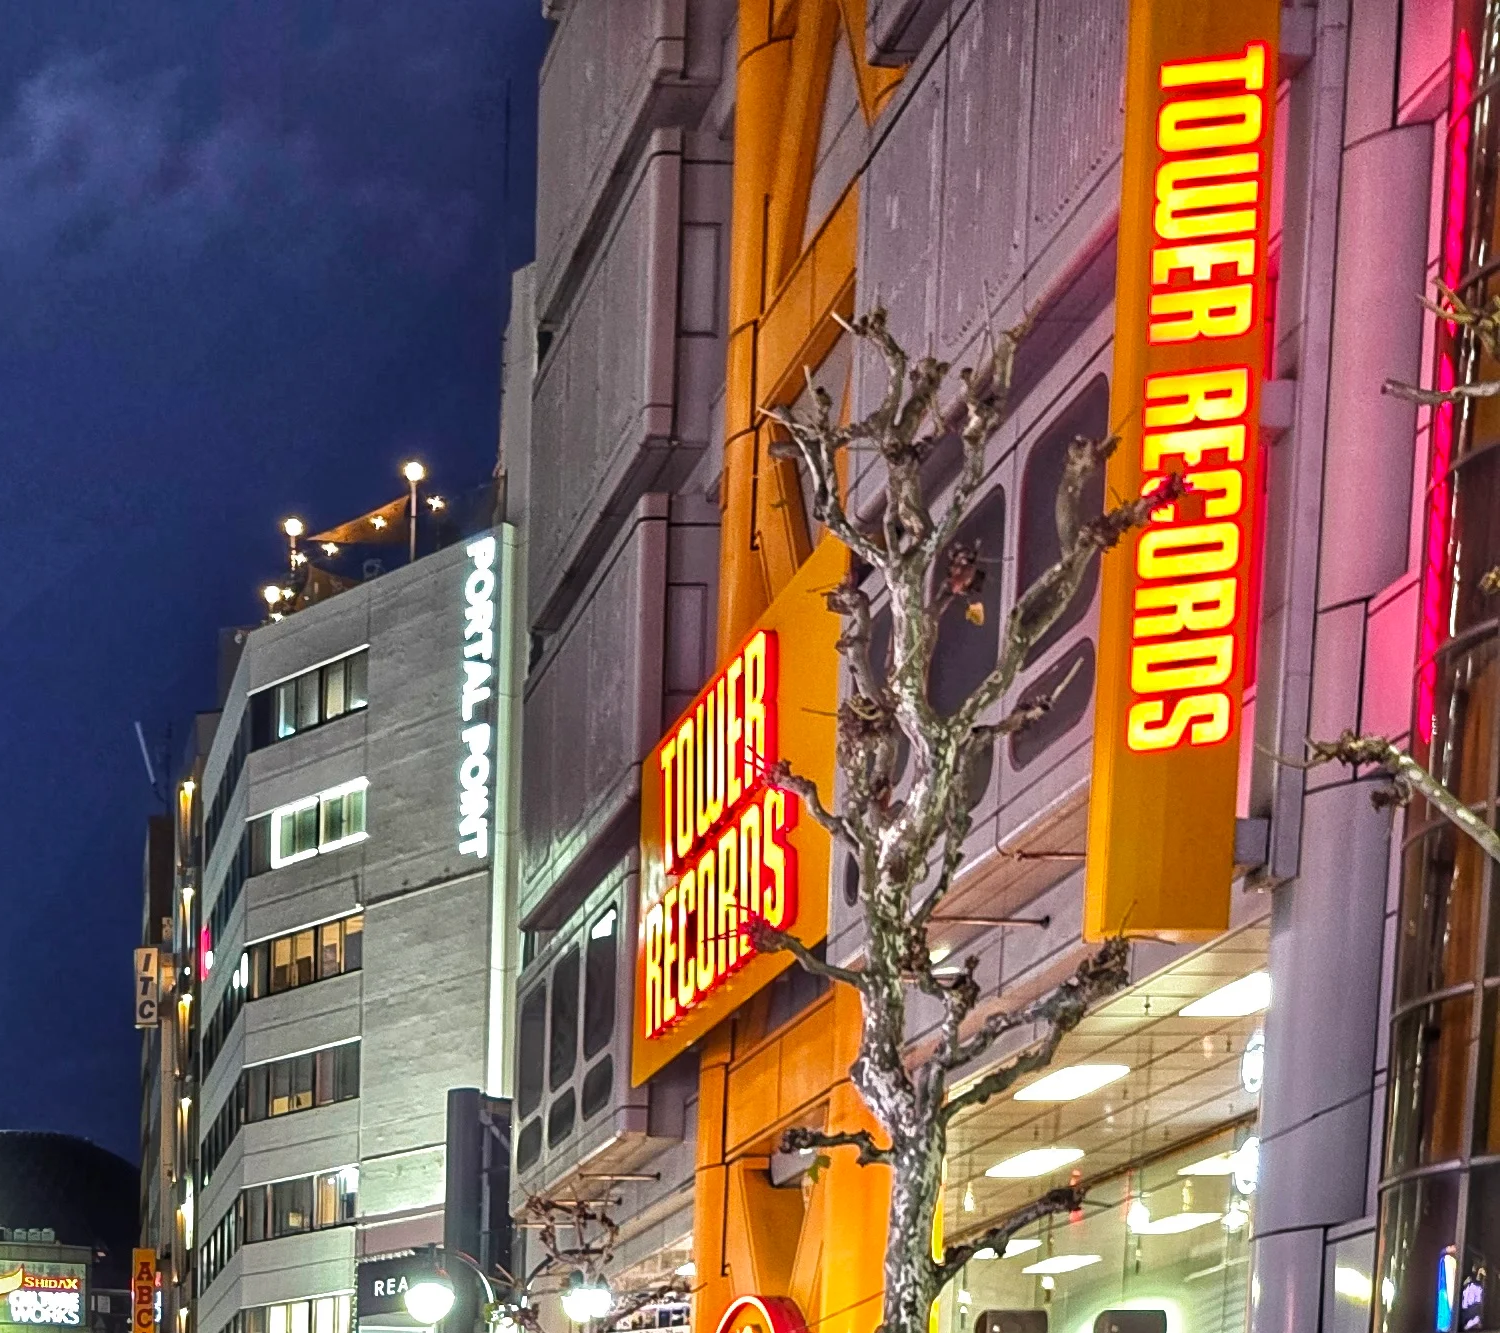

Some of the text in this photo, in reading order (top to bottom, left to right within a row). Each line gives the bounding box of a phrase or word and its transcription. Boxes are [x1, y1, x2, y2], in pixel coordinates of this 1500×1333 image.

[1128, 45, 1264, 753] TOWER RECORDS
[459, 536, 496, 859] PORTAL POINT
[660, 632, 767, 873] TOWER
[139, 953, 155, 1019] ITC
[644, 788, 785, 1038] RECORDS
[11, 1305, 80, 1325] WORKS
[24, 1276, 78, 1290] SHIDAX
[374, 1276, 409, 1297] REA
